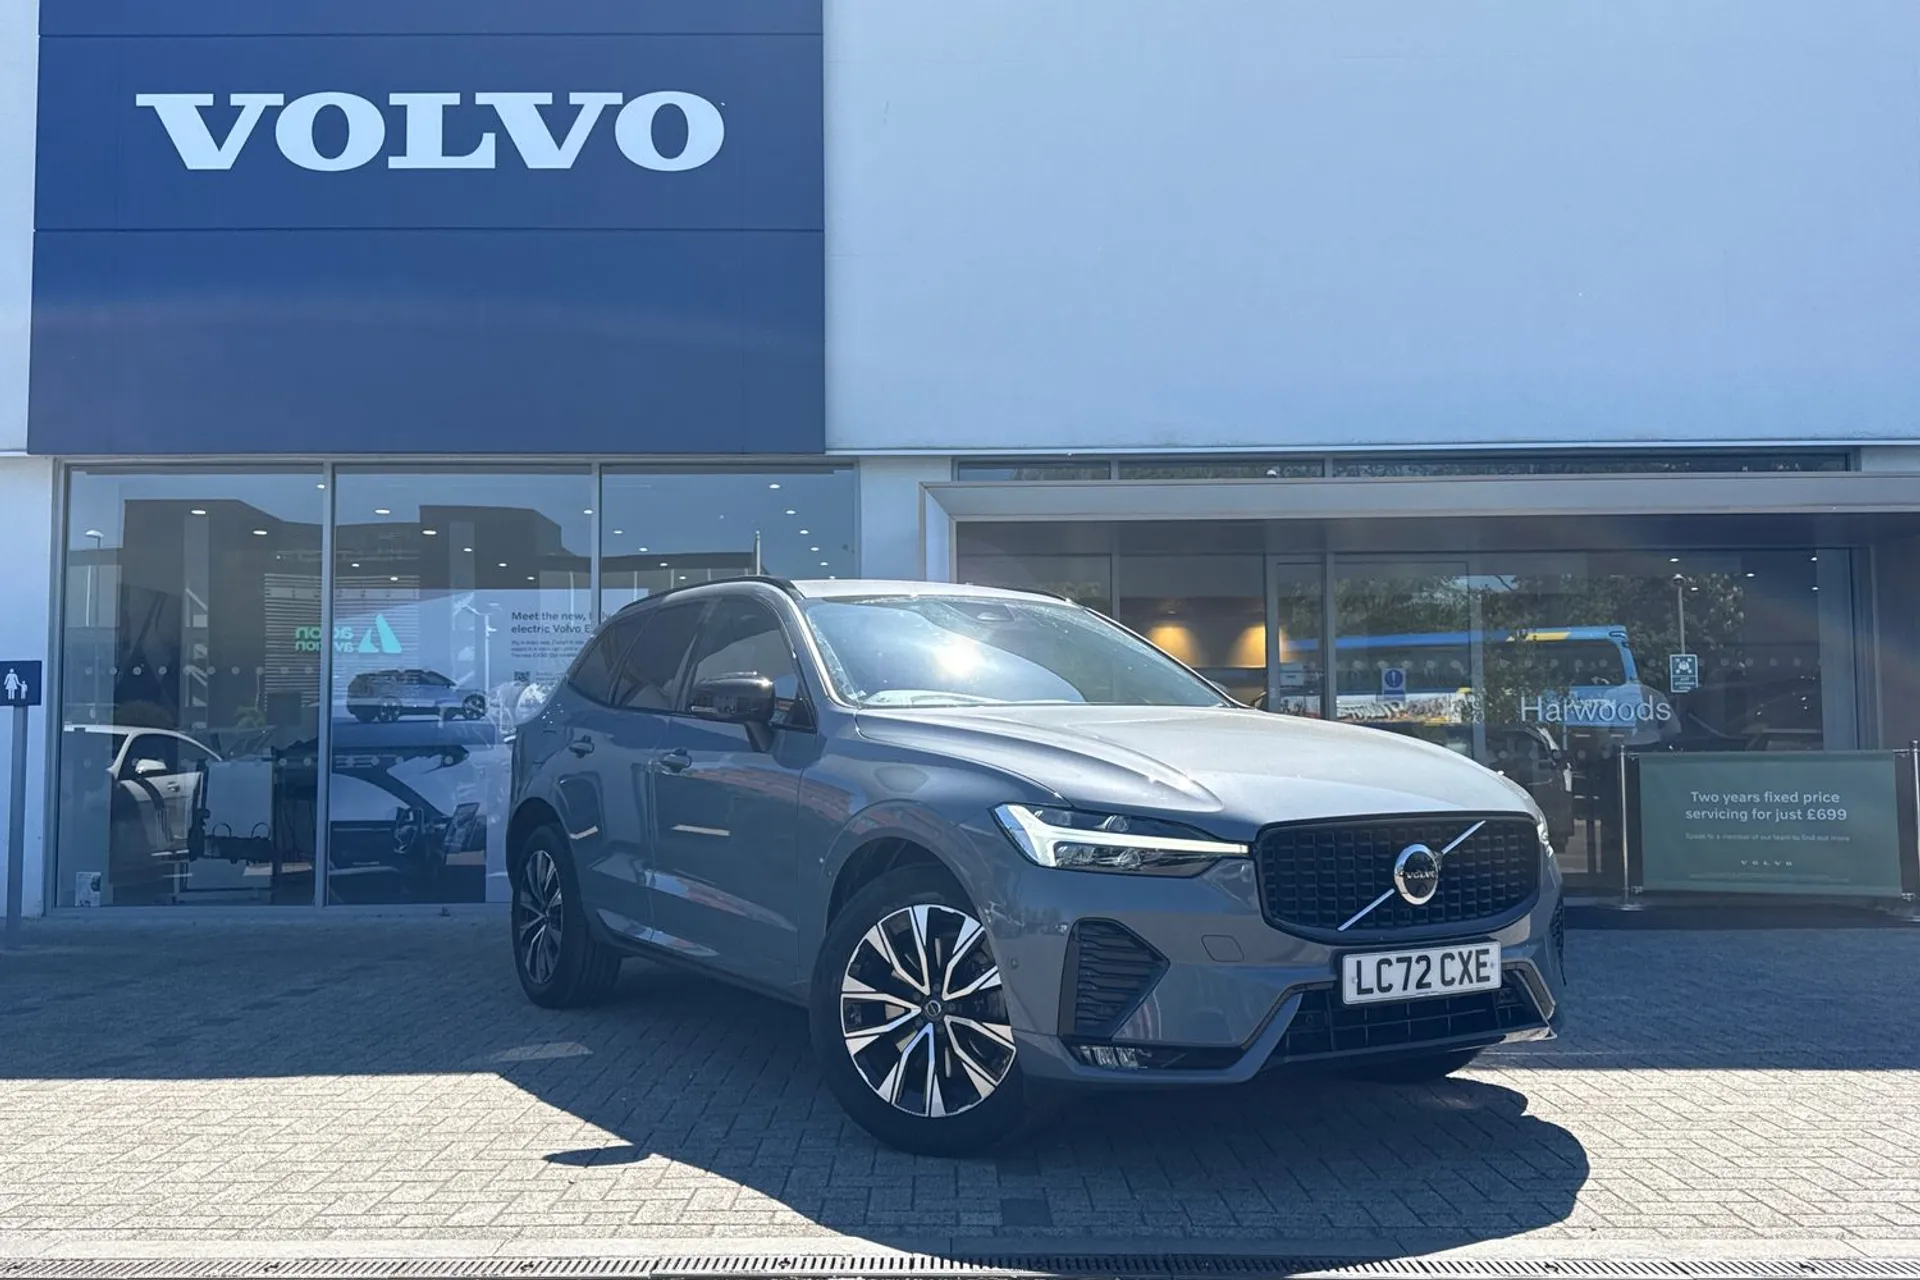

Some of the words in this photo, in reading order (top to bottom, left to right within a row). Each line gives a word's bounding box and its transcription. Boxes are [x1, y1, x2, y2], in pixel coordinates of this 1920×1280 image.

[136, 91, 724, 172] VOLVO
[511, 611, 539, 621] Meet
[541, 611, 559, 621] the
[511, 624, 550, 634] electric
[552, 624, 580, 634] Volvo
[1520, 694, 1671, 722] Harwoods
[1690, 791, 1719, 803] Two
[1722, 793, 1760, 805] years
[1763, 791, 1799, 803] fixed
[1803, 791, 1840, 805] price
[1685, 808, 1748, 822] servicing
[1751, 808, 1772, 820] for
[1775, 808, 1803, 822] just
[1806, 808, 1847, 821] £699
[1355, 954, 1432, 996] LC72
[1439, 948, 1491, 988] CXE
